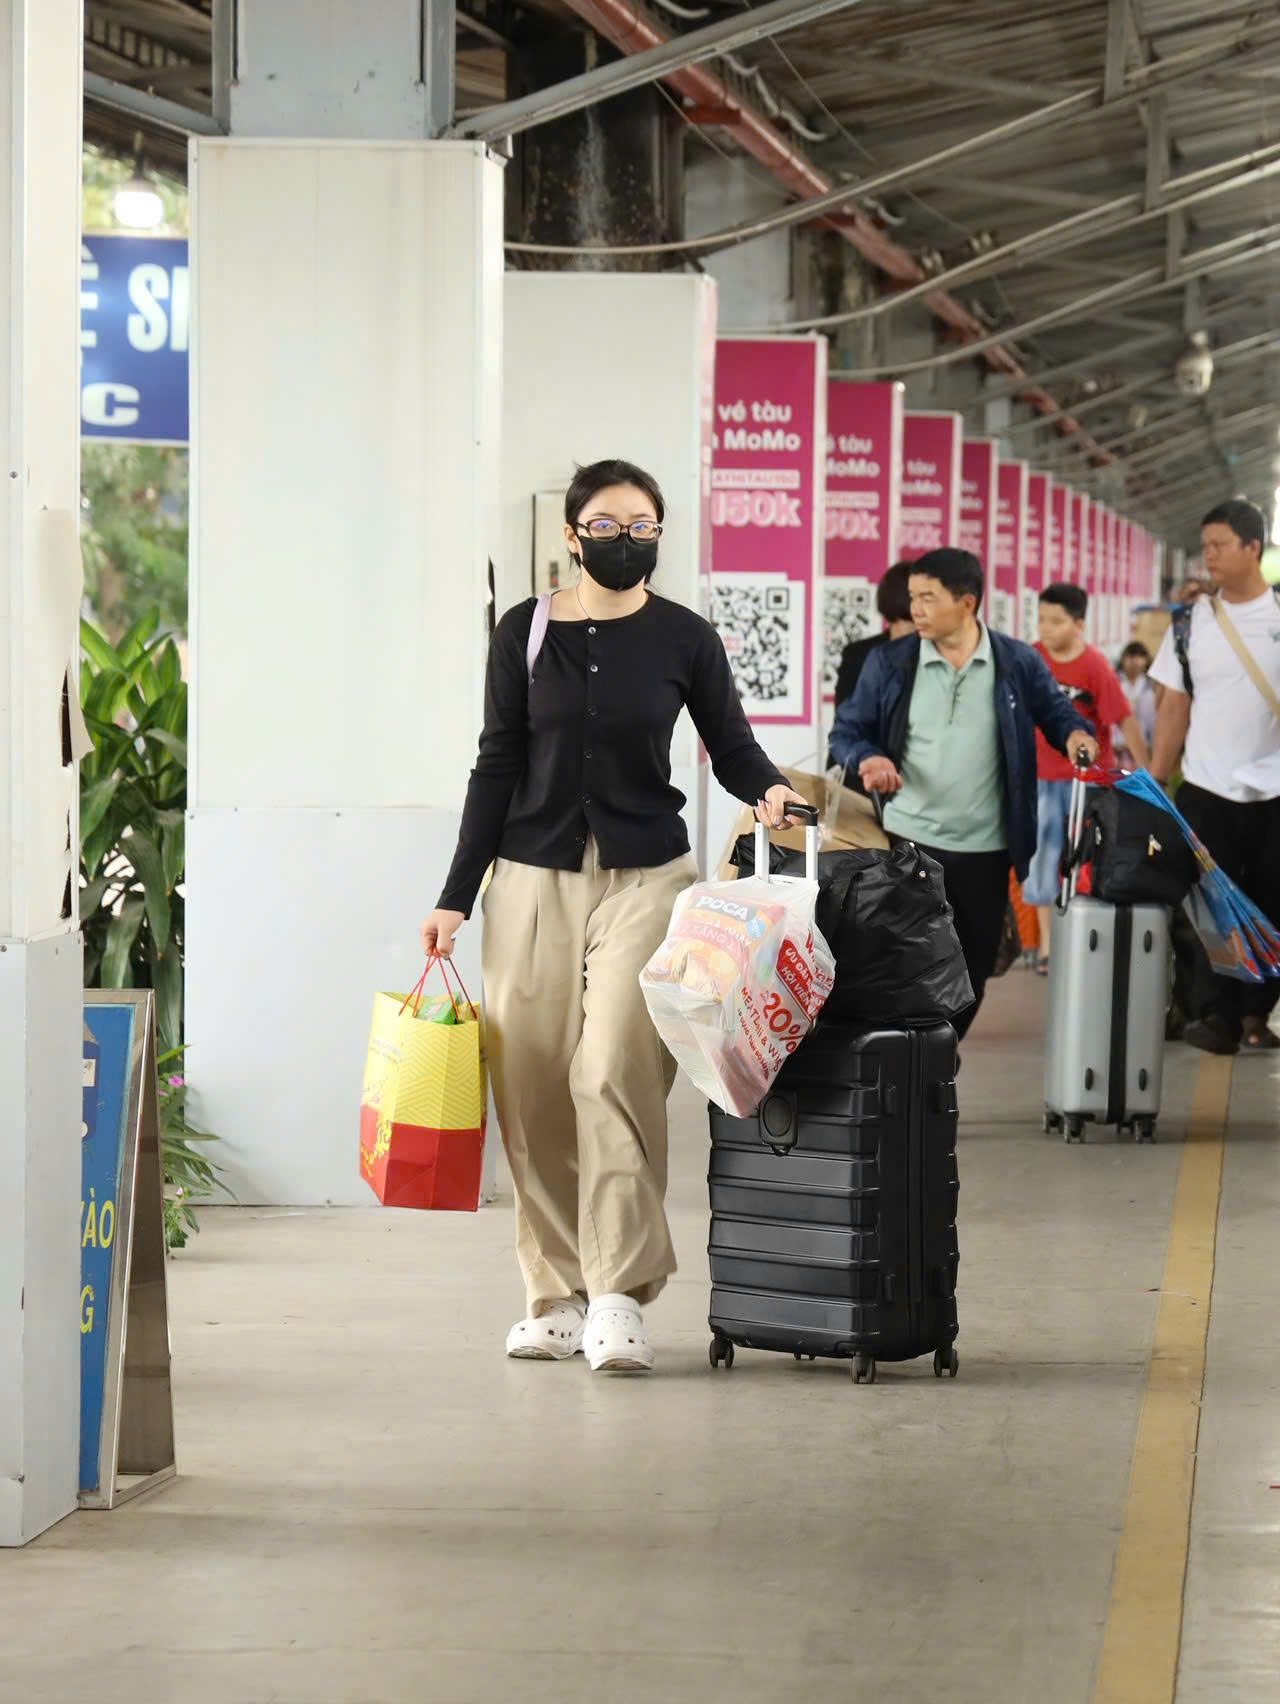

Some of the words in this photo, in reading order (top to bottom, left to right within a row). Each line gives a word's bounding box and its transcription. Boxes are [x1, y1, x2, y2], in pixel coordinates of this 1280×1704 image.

[718, 400, 747, 422] vé
[751, 400, 792, 423] tàu
[724, 429, 801, 450] MoMo
[696, 895, 749, 920] POCA
[763, 992, 804, 1053] 20%
